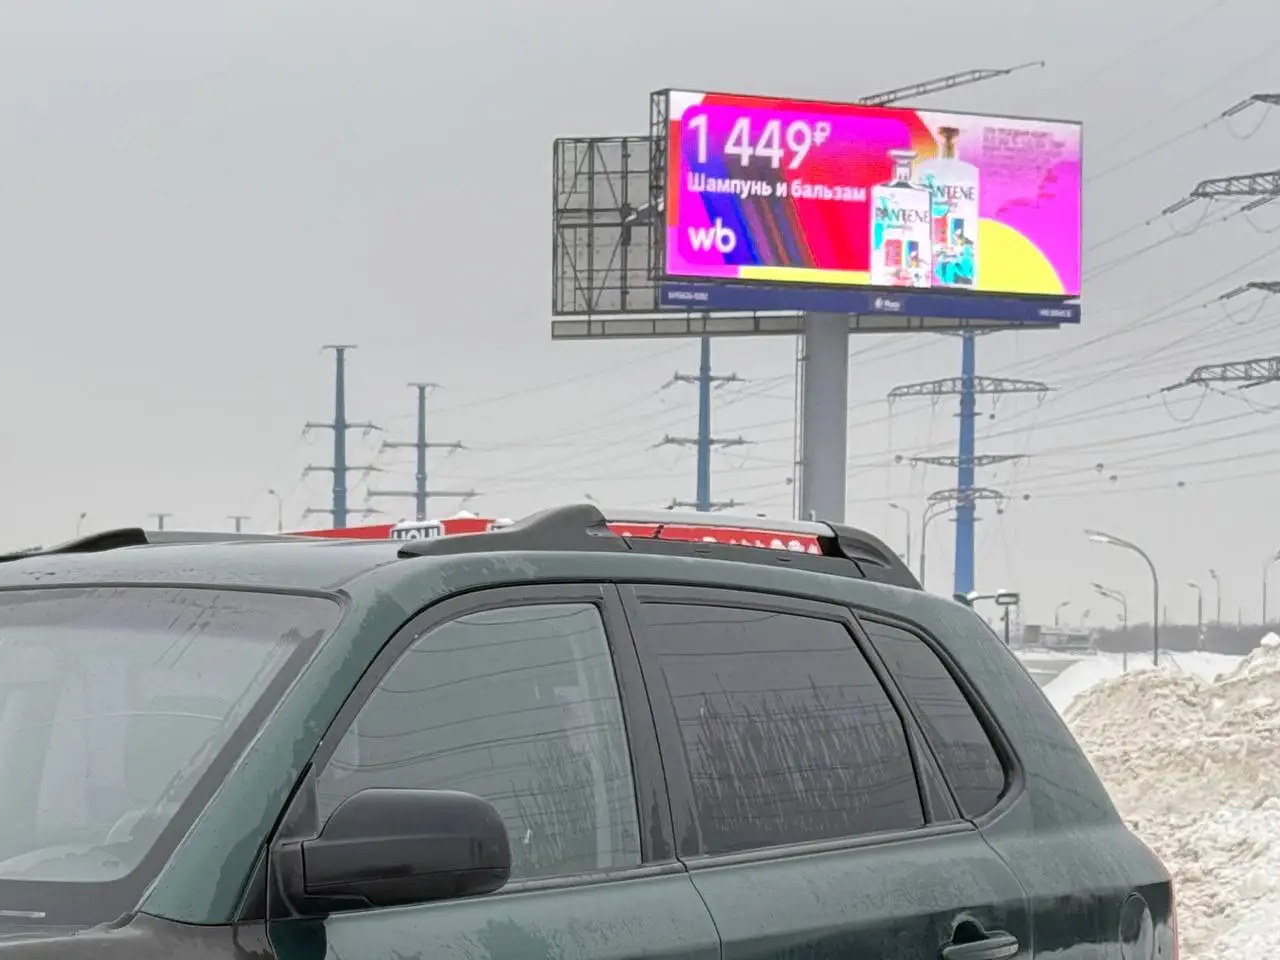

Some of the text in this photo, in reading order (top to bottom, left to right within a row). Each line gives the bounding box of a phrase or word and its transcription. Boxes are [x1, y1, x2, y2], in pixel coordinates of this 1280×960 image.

[687, 171, 867, 203] Шампунь и бальзам
[687, 217, 737, 254] wb
